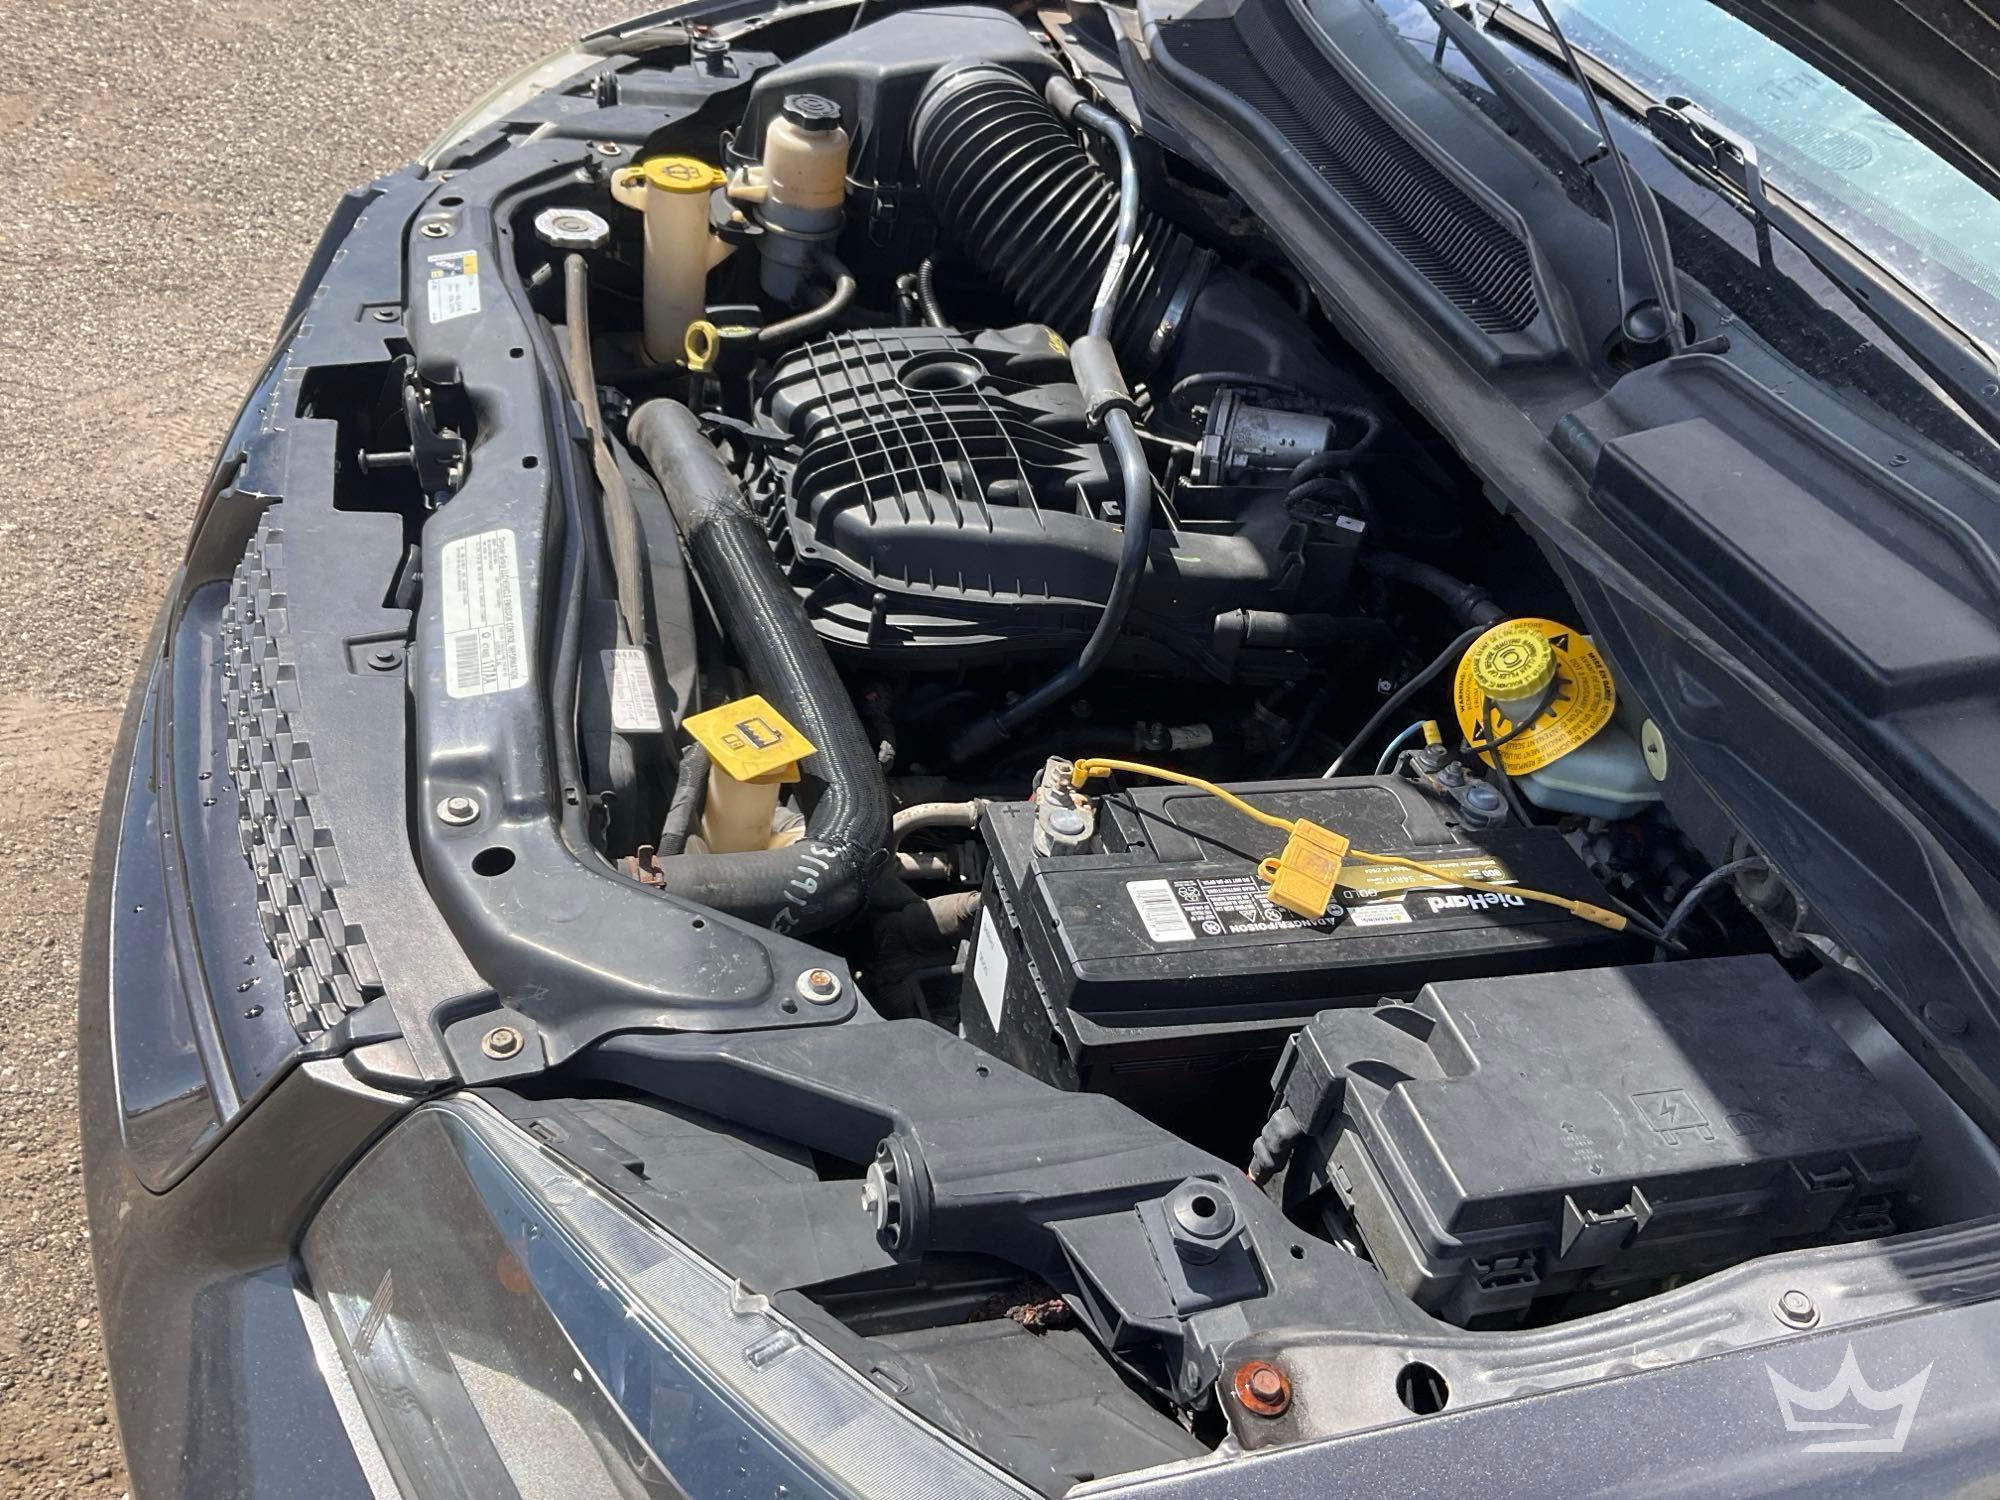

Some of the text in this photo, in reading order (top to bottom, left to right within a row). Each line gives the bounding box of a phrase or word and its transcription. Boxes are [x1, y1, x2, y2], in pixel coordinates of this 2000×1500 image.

[1514, 622, 1542, 630] BEFORE
[1582, 727, 1590, 737] LE
[1342, 888, 1377, 899] GOLD
[1427, 892, 1525, 913] DieHard
